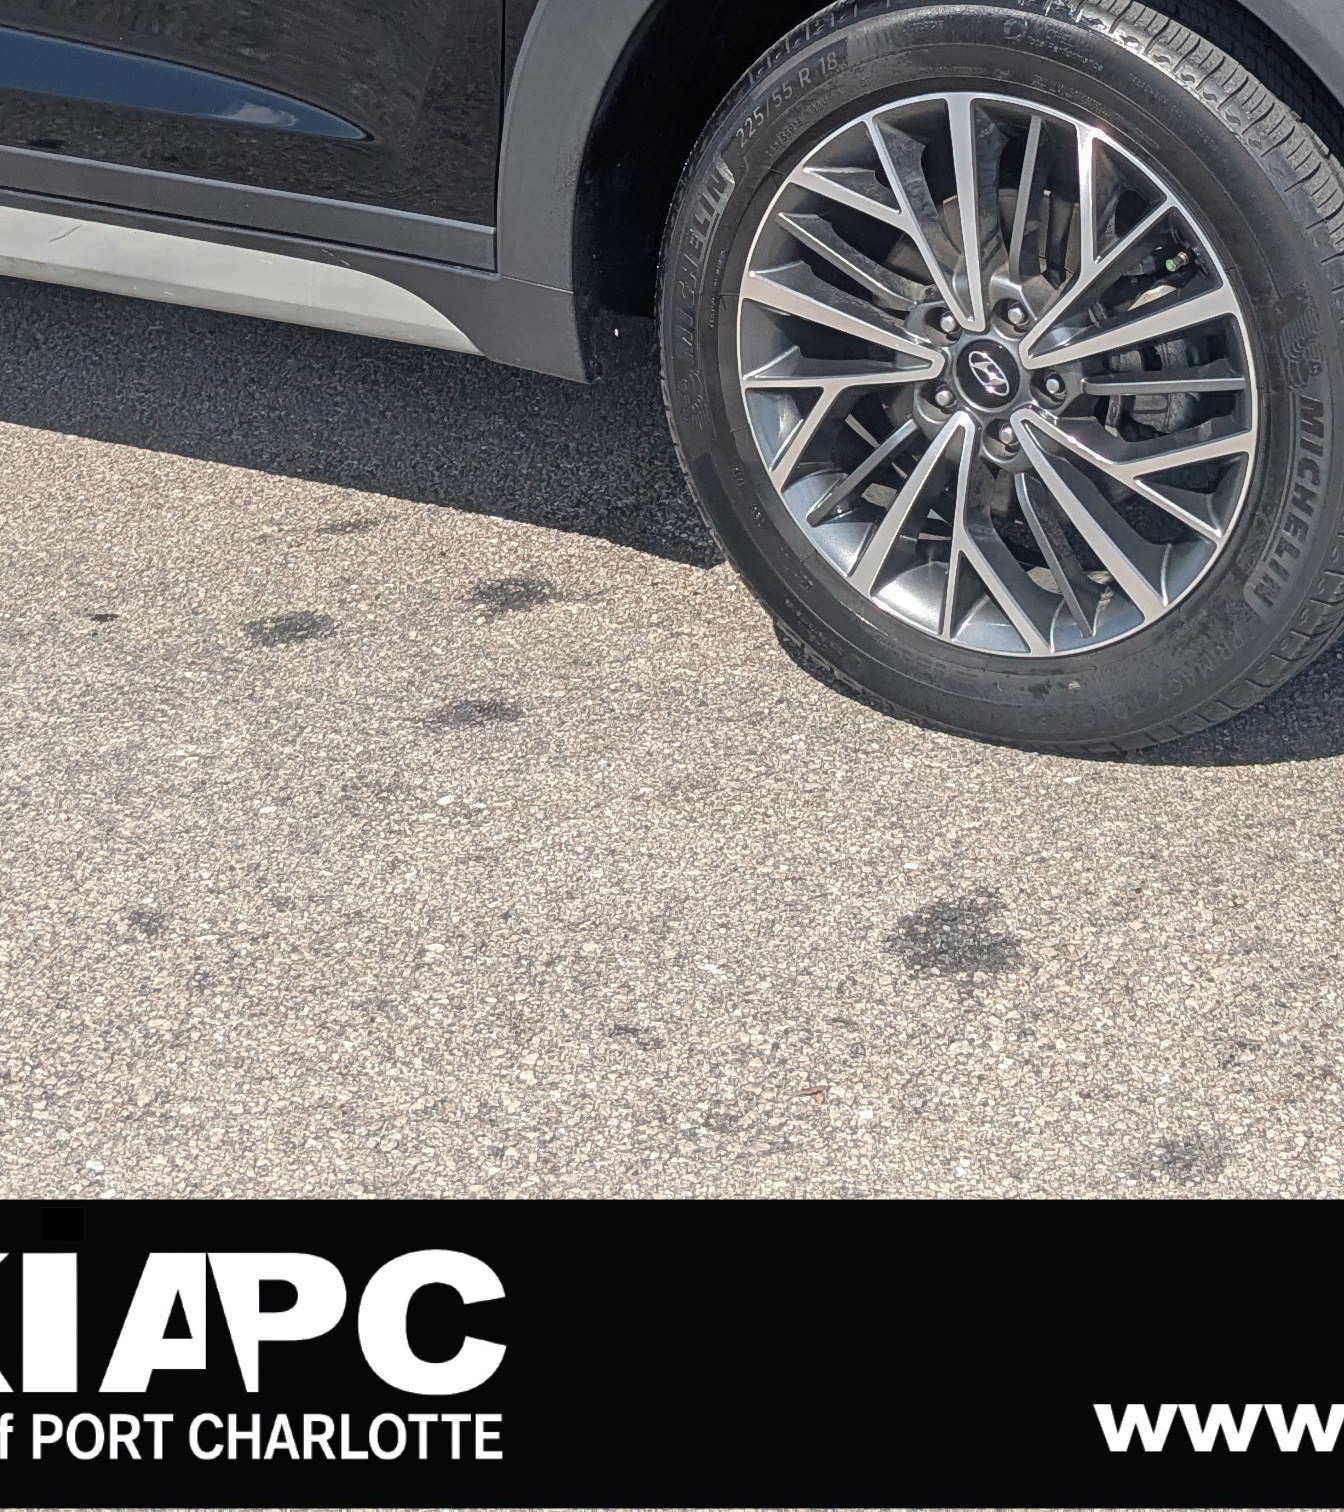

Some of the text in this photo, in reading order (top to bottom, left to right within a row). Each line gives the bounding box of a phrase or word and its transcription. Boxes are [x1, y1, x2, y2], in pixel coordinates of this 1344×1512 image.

[735, 81, 793, 148] 225/55
[798, 67, 812, 88] R
[818, 51, 838, 75] 18
[1253, 394, 1324, 608] MICHELIN
